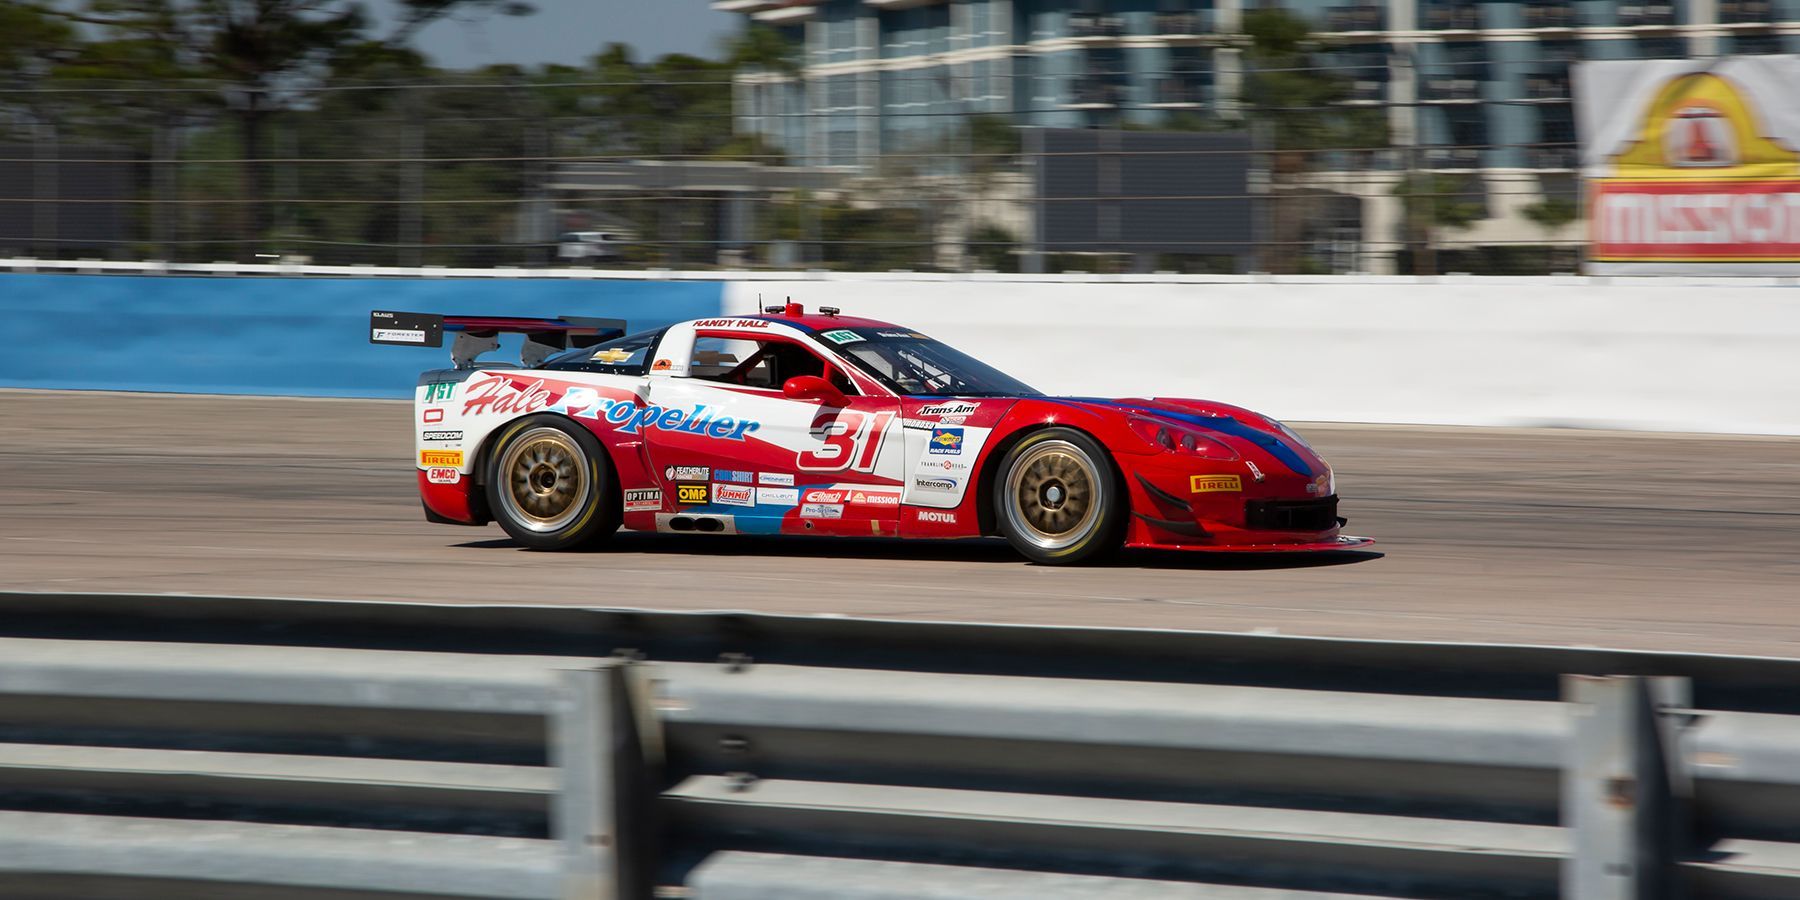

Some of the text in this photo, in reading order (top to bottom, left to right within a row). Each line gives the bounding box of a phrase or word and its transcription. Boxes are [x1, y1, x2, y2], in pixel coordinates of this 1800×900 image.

[736, 320, 770, 328] HALE
[462, 376, 761, 441] Hale Propeller
[921, 405, 975, 415] Trans Am
[423, 432, 463, 440] SPEEDCOM
[797, 408, 896, 473] 31
[422, 452, 460, 464] PIRELLI
[431, 469, 456, 479] EMCO
[676, 466, 709, 475] FEATHERLITE
[916, 479, 953, 490] Intercomp
[1196, 477, 1239, 490] PIRELLI
[627, 491, 659, 501] OPTIMA
[678, 489, 707, 500] OMP
[918, 511, 956, 523] MOTUL
